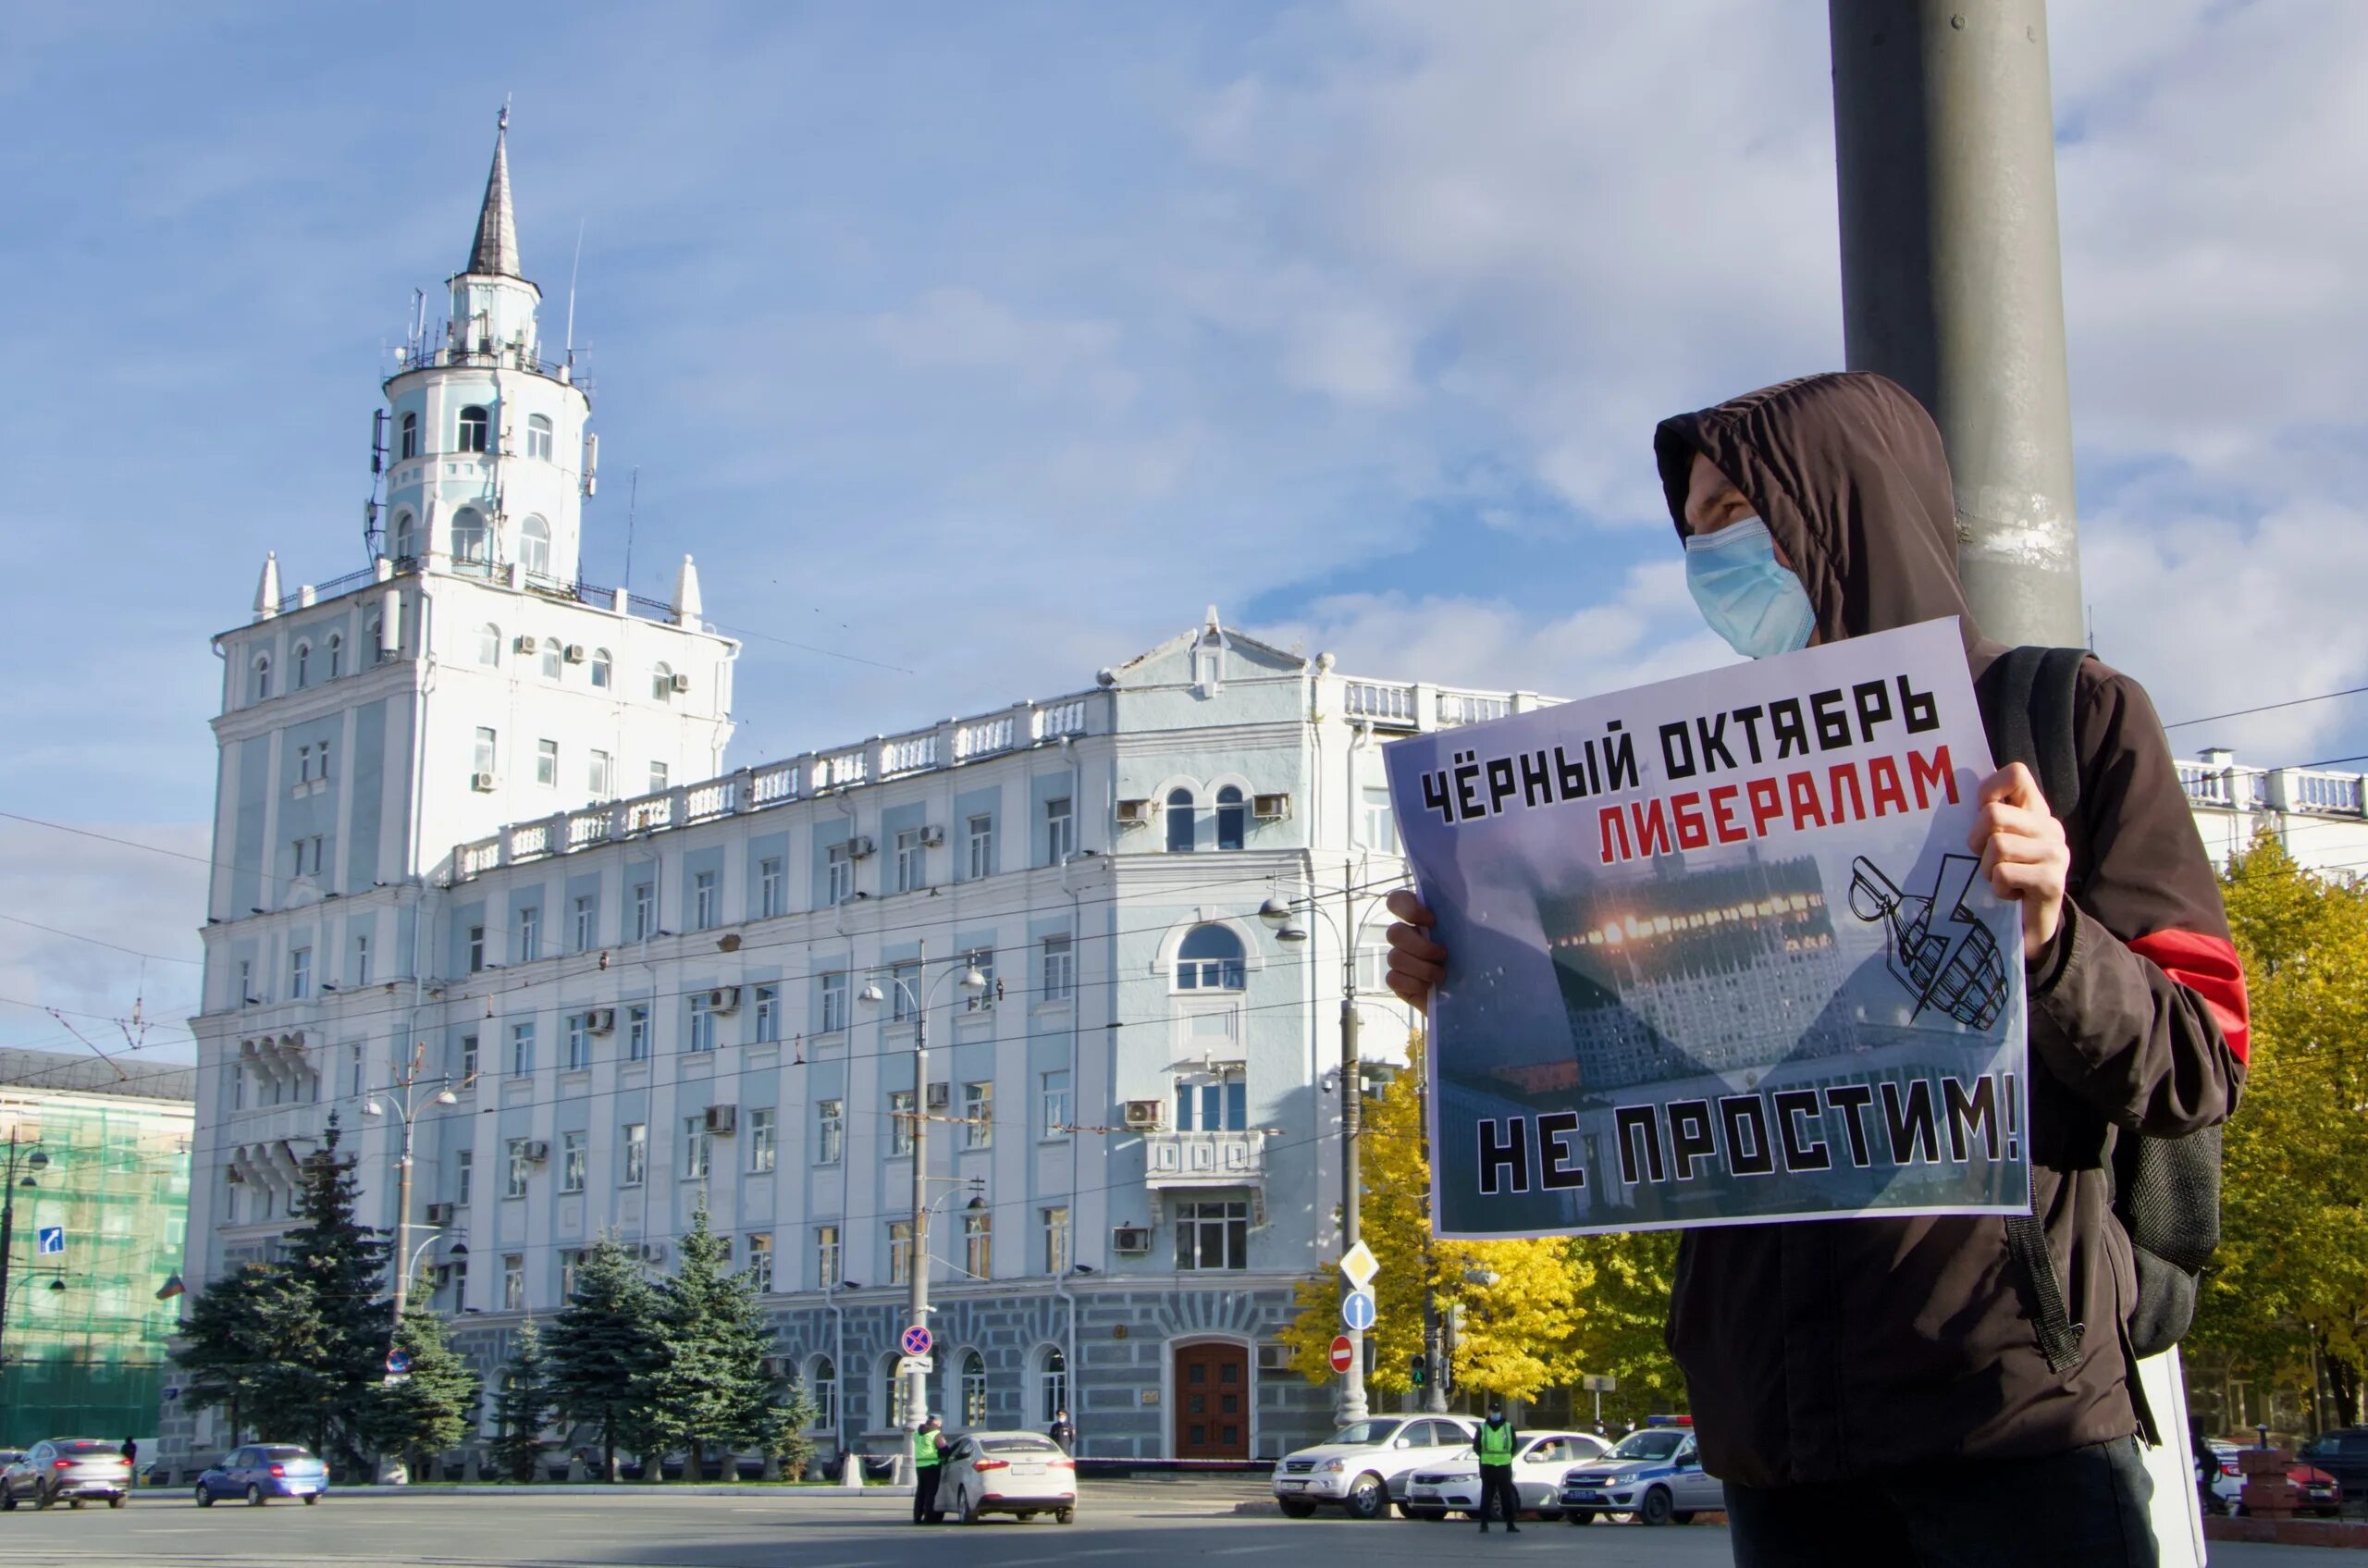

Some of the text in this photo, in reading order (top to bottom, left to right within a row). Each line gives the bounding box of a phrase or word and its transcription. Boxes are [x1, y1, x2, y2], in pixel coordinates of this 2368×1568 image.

[1423, 674, 1940, 823] ЧЁРНЫЙ ОКТЯБРЬ
[1599, 745, 1960, 863] ЛИБЕРАЛАМ
[1479, 1073, 2019, 1194] НЕ ПРОСТИМ!
